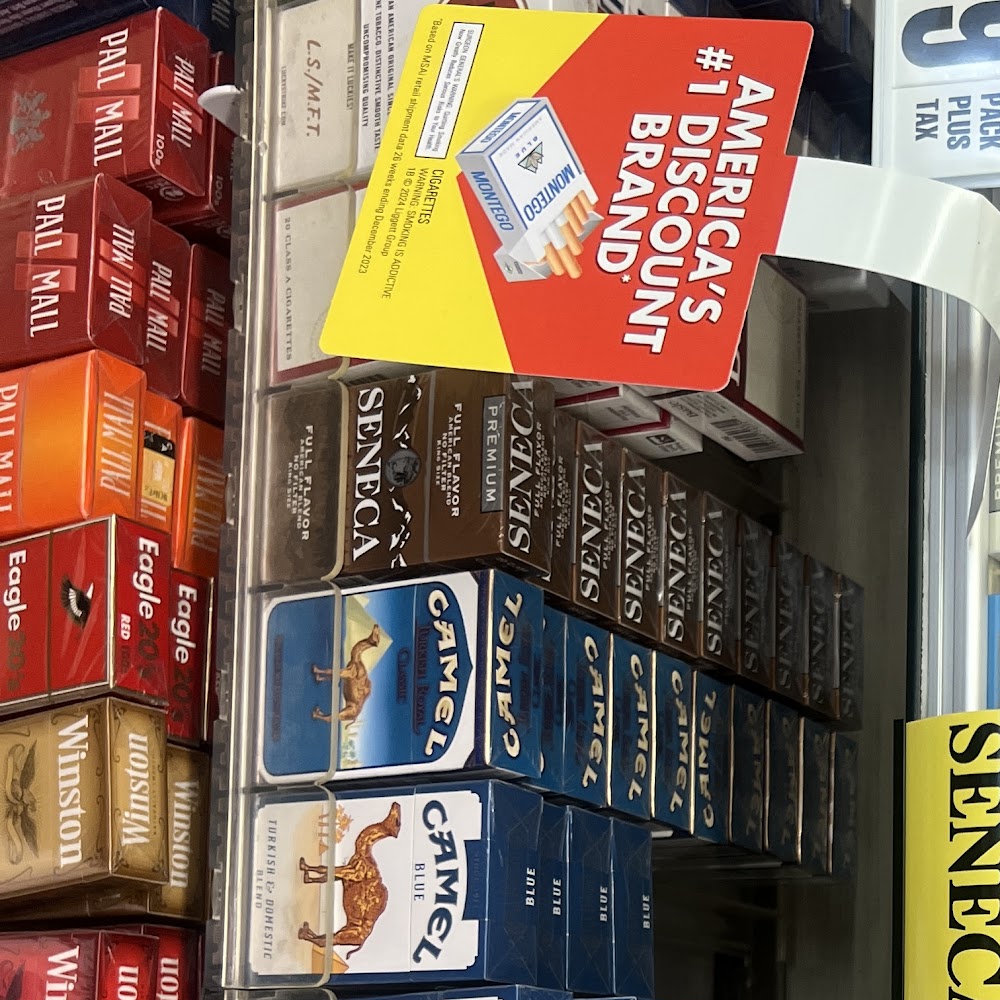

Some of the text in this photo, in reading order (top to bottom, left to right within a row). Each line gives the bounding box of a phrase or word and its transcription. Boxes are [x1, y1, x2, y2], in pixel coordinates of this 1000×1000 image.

[423, 44, 435, 54] on
[457, 29, 466, 40] Now
[461, 29, 475, 54] SURGEON
[412, 77, 424, 97] retail
[453, 55, 468, 82] GENERAL'S
[688, 46, 734, 95] #1
[93, 29, 128, 167] PALL MALL
[401, 98, 418, 132] shipment
[914, 99, 939, 142] TAX
[946, 96, 971, 150] PLUS
[392, 151, 404, 162] 26
[395, 133, 408, 150] data
[432, 131, 445, 152] Smoking
[375, 188, 391, 214] ending
[384, 163, 398, 187] weeks
[397, 188, 410, 206] 2024
[417, 169, 445, 225] CIGARETTES
[470, 171, 514, 231] MONTEGO
[523, 164, 575, 222] MONTEGO
[678, 75, 775, 324] AMERICA'S
[364, 215, 384, 253] December
[380, 234, 395, 257] Group
[381, 168, 429, 299] WARNING: SMOKING IS ADDICTIVE
[388, 208, 405, 233] Liggett
[622, 115, 721, 354] DISCOUNT
[30, 194, 66, 338] PALL MALL
[358, 254, 372, 274] 2023
[285, 287, 293, 361] CIGARETTES
[352, 388, 385, 562] SENECA
[451, 403, 462, 517] FULL FLAVOR
[485, 406, 498, 502] PREMIUM
[301, 425, 313, 541] FULL FLAVOR
[4, 549, 27, 632] Eagle
[133, 537, 161, 619] Eagle
[170, 584, 198, 663] Eagle
[424, 589, 458, 756] CAMEL
[495, 593, 523, 758] CAMEL
[57, 715, 89, 869] Winston
[120, 733, 151, 847] Winston
[170, 780, 198, 888] Winston
[266, 820, 278, 875] TURKISH
[255, 869, 264, 909] BLEND
[412, 800, 460, 963] CAMEL
[413, 863, 425, 901] BLUE
[525, 867, 536, 906] BLUE
[263, 899, 274, 960] DOMESTIC
